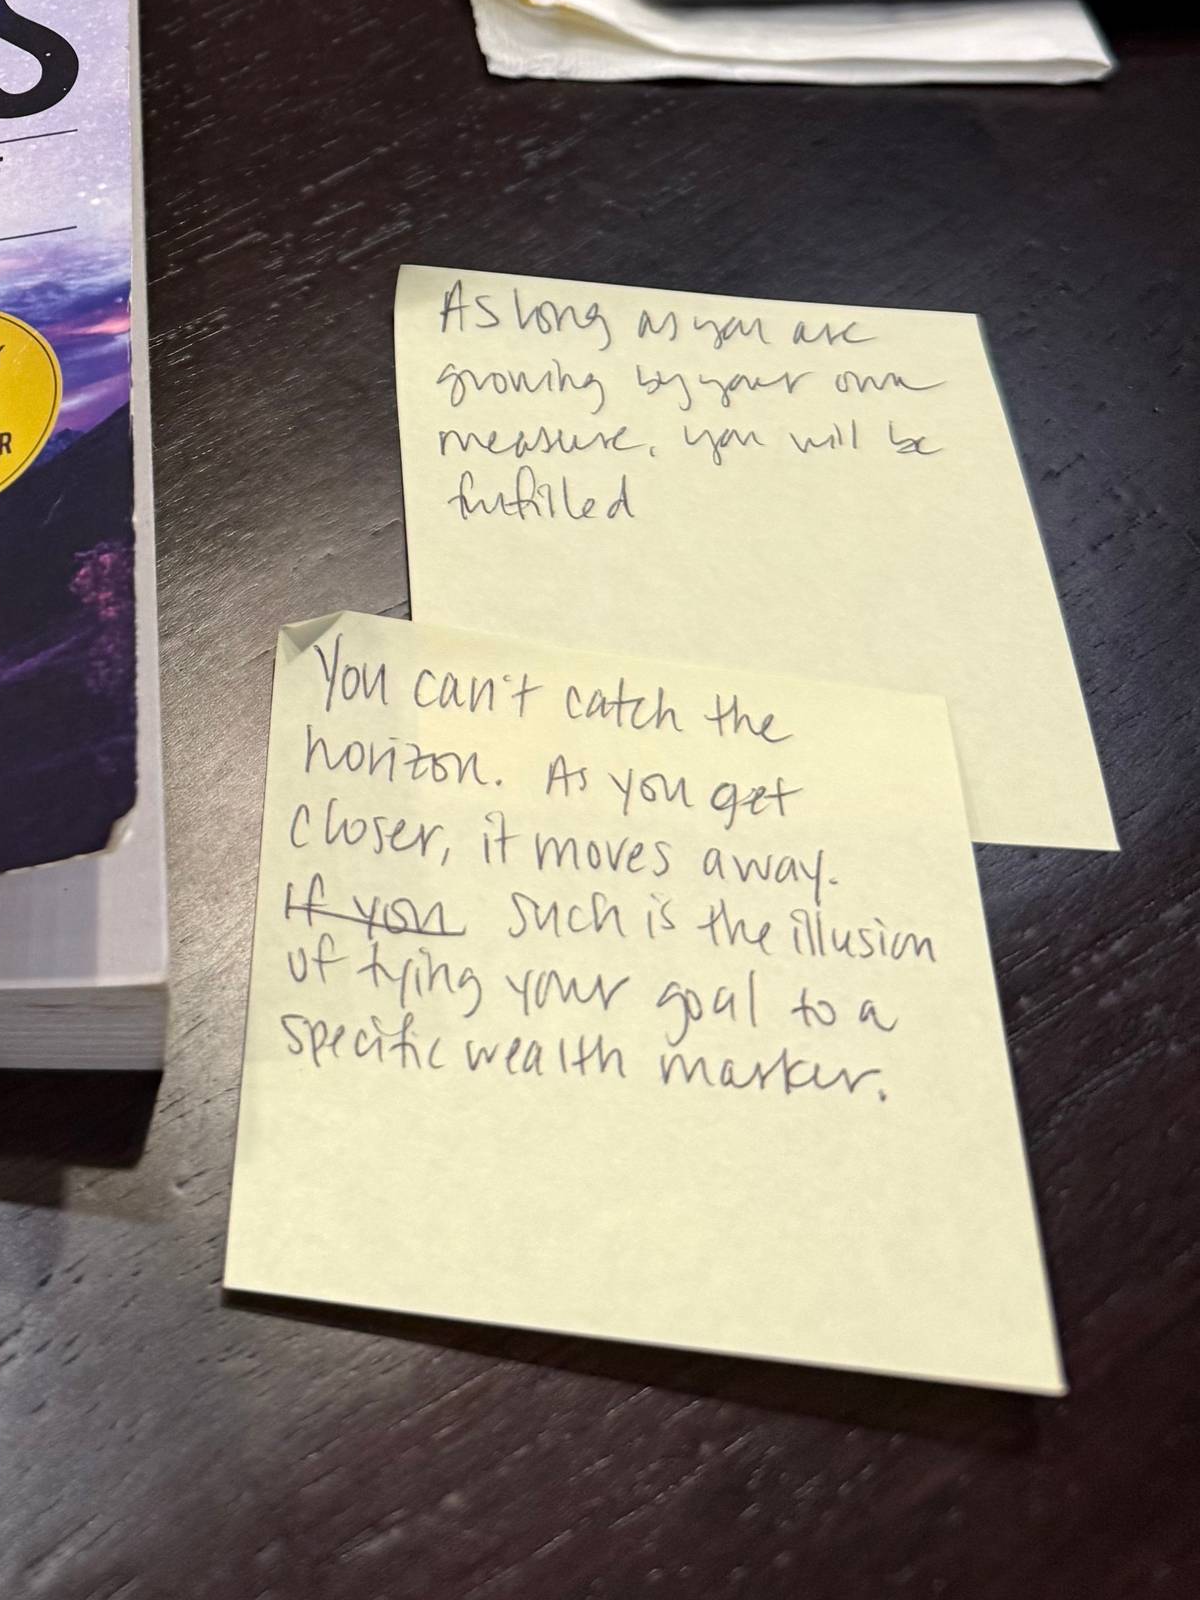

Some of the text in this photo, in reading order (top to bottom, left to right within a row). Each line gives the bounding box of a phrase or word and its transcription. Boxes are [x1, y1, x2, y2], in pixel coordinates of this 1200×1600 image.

[439, 280, 877, 354] As long as you are
[436, 359, 946, 415] growing by your own
[683, 425, 765, 466] you
[790, 420, 859, 453] will
[889, 420, 942, 456] be
[313, 634, 793, 744] You can't catch the
[304, 725, 802, 829] horizon. As you get
[290, 799, 837, 905] closer, it moves away.
[353, 895, 455, 940] you
[508, 891, 630, 940] such
[647, 896, 676, 934] is
[698, 899, 785, 954] the
[790, 909, 936, 962] illusion
[288, 933, 898, 1045] of tying your goal to a
[282, 1012, 887, 1101] specific wealth marker.
